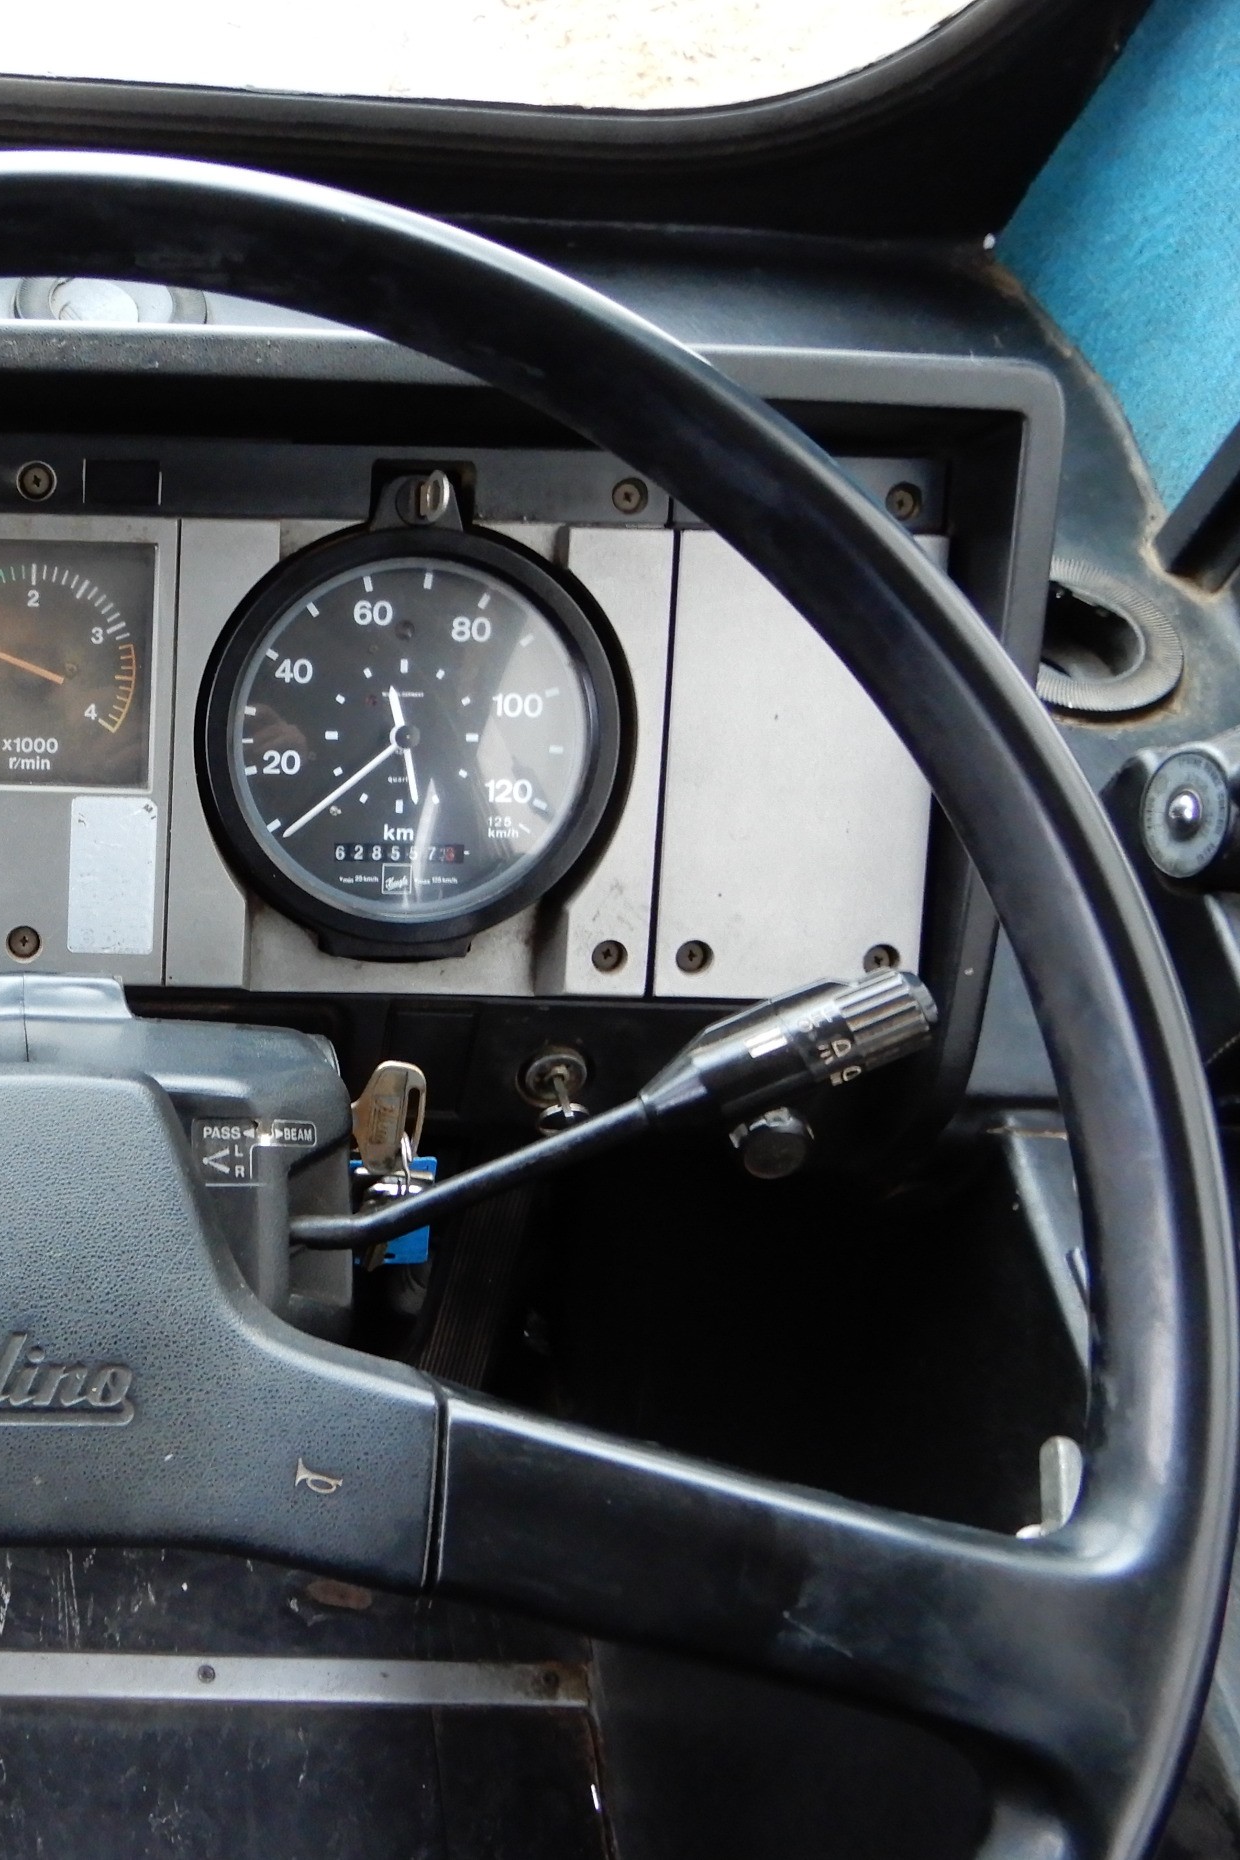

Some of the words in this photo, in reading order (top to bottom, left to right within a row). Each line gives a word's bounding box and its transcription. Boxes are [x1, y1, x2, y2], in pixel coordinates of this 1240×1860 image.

[27, 589, 40, 608] 2
[353, 600, 394, 626] 60
[91, 627, 104, 645] 3
[451, 616, 492, 643] 80
[274, 658, 313, 684] 40
[84, 703, 98, 720] 4
[492, 692, 543, 718] 100
[8, 756, 51, 771] r/min
[262, 750, 301, 776] 20
[484, 778, 533, 804] 120
[383, 823, 415, 841] km
[488, 827, 519, 839] km/h
[203, 1125, 241, 1139] PASS
[283, 1128, 313, 1141] BEAM
[234, 1144, 244, 1158] L
[235, 1164, 245, 1178] R
